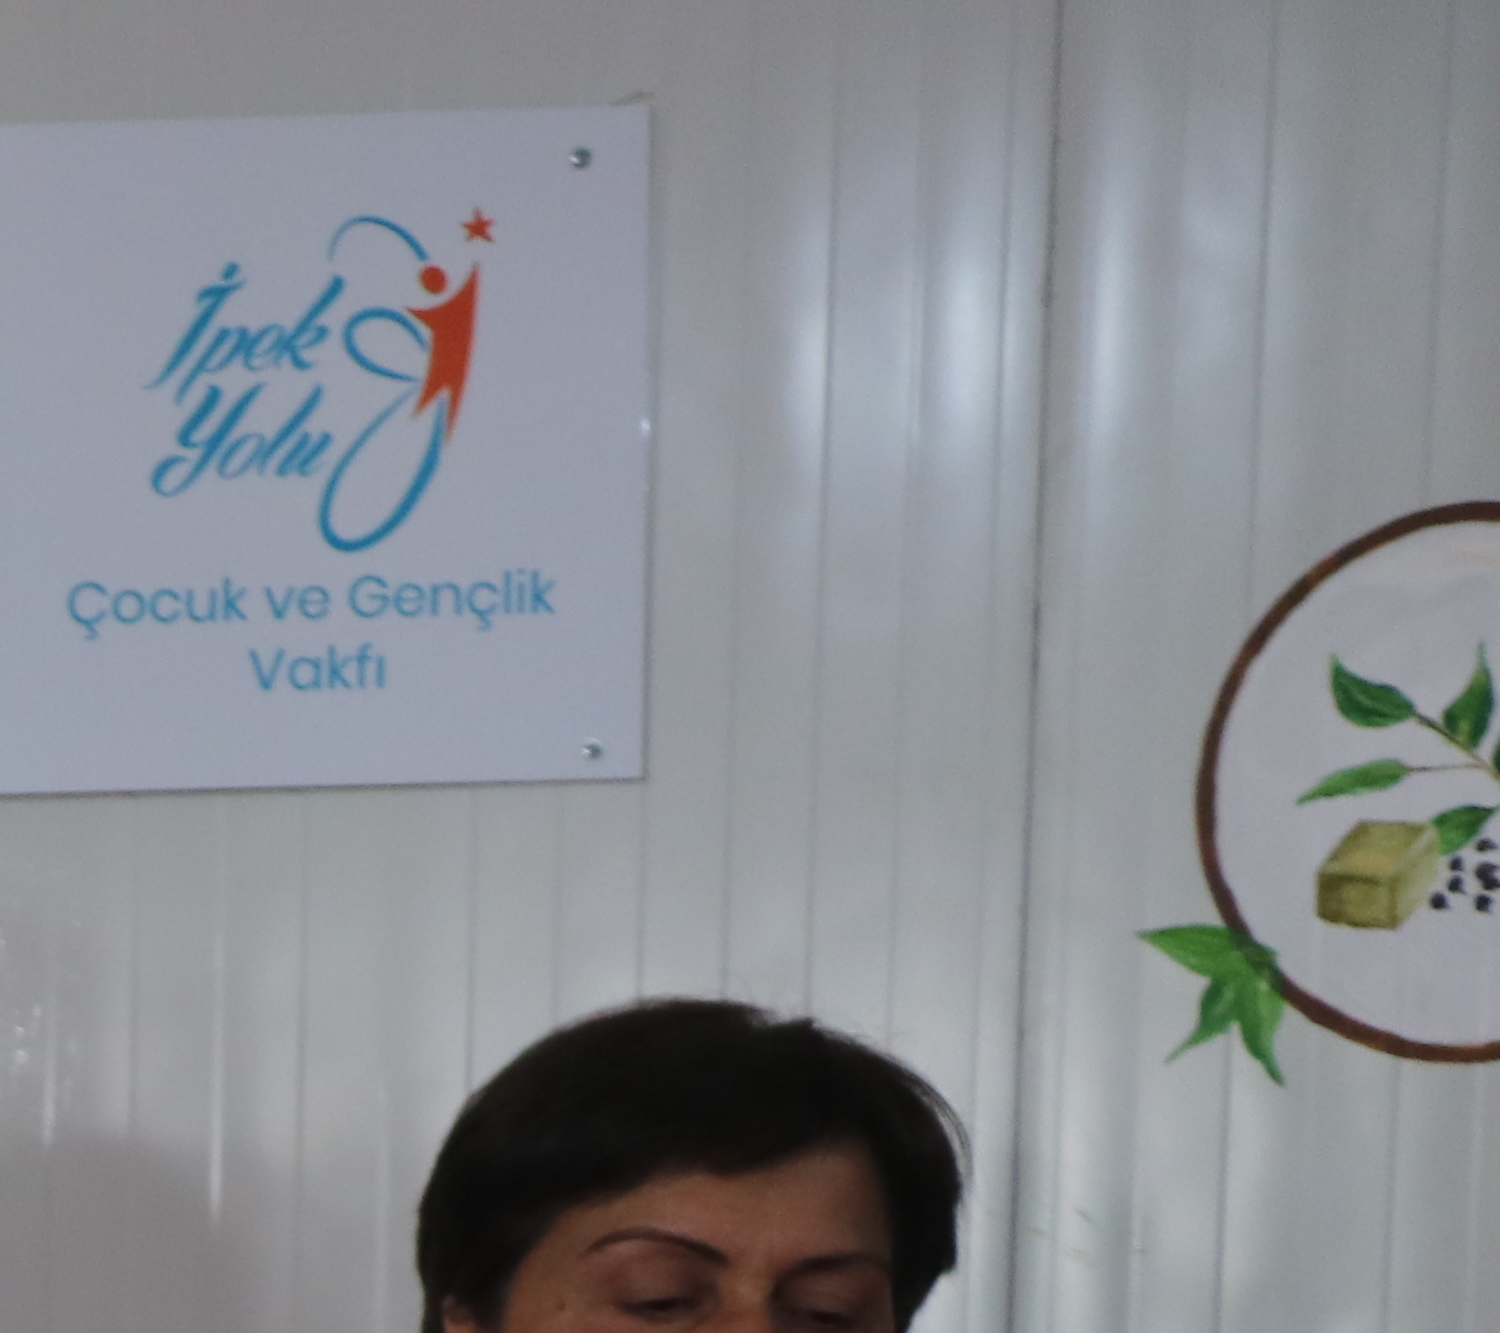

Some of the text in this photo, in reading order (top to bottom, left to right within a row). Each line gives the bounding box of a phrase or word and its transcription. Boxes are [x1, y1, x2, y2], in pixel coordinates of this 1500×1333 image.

[143, 262, 346, 405] İpek
[150, 383, 334, 497] Yolu
[65, 569, 556, 641] Çocuk ve Gençlik
[248, 642, 388, 692] Vakfı
